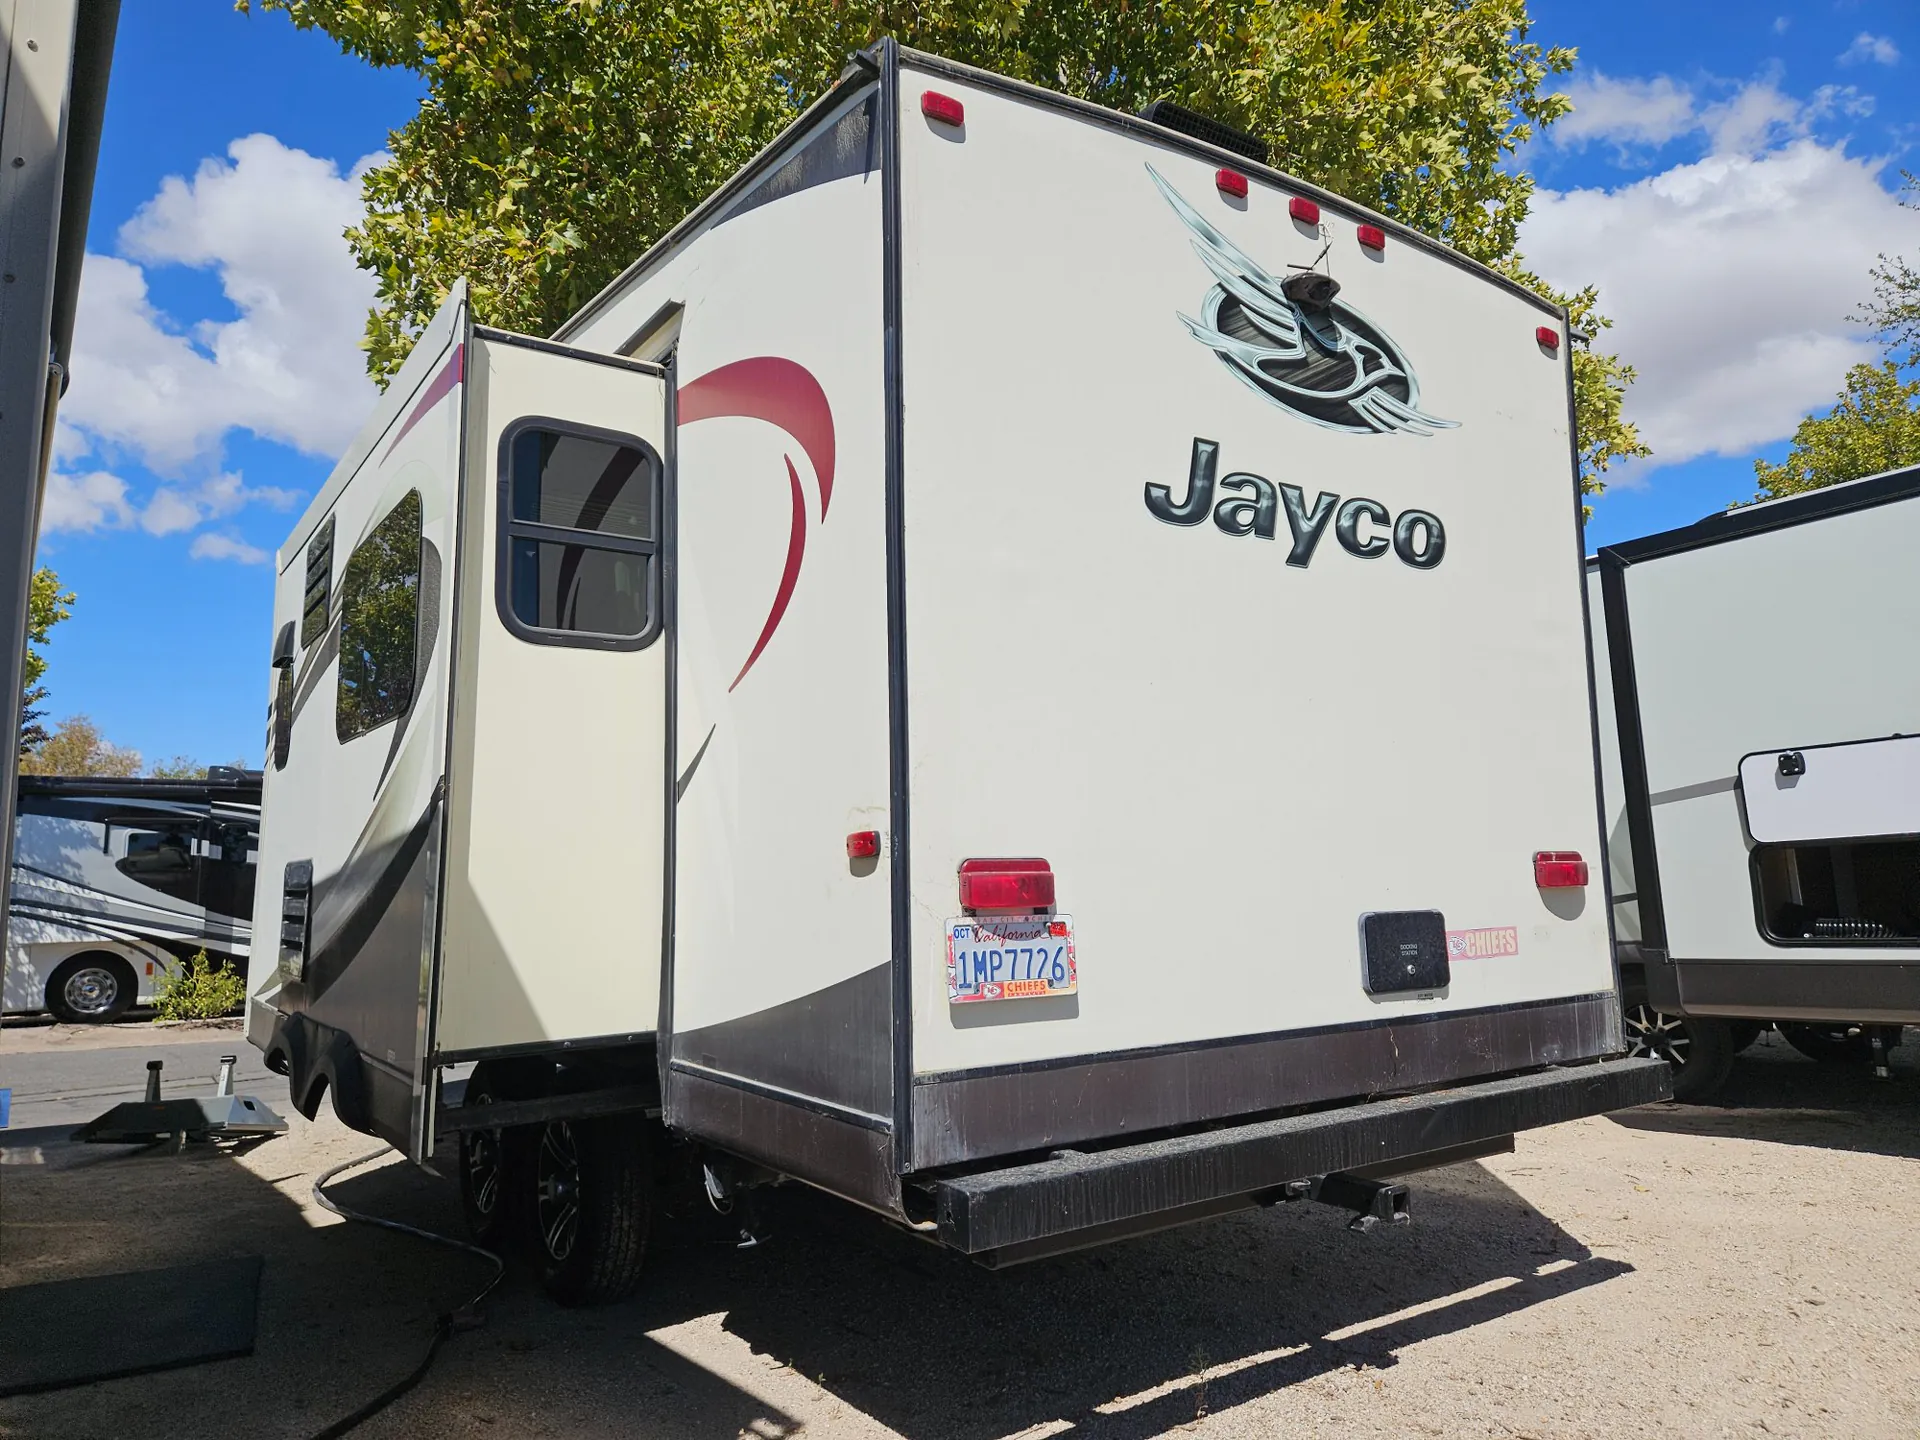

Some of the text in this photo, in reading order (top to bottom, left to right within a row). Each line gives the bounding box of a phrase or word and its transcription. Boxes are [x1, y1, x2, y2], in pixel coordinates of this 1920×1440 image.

[1144, 436, 1446, 570] Jayco
[953, 927, 970, 939] OCT
[972, 923, 1049, 947] California
[1464, 929, 1517, 957] CHIEFS
[958, 946, 1065, 989] 1MP7726
[1007, 980, 1046, 992] CHIEFS
